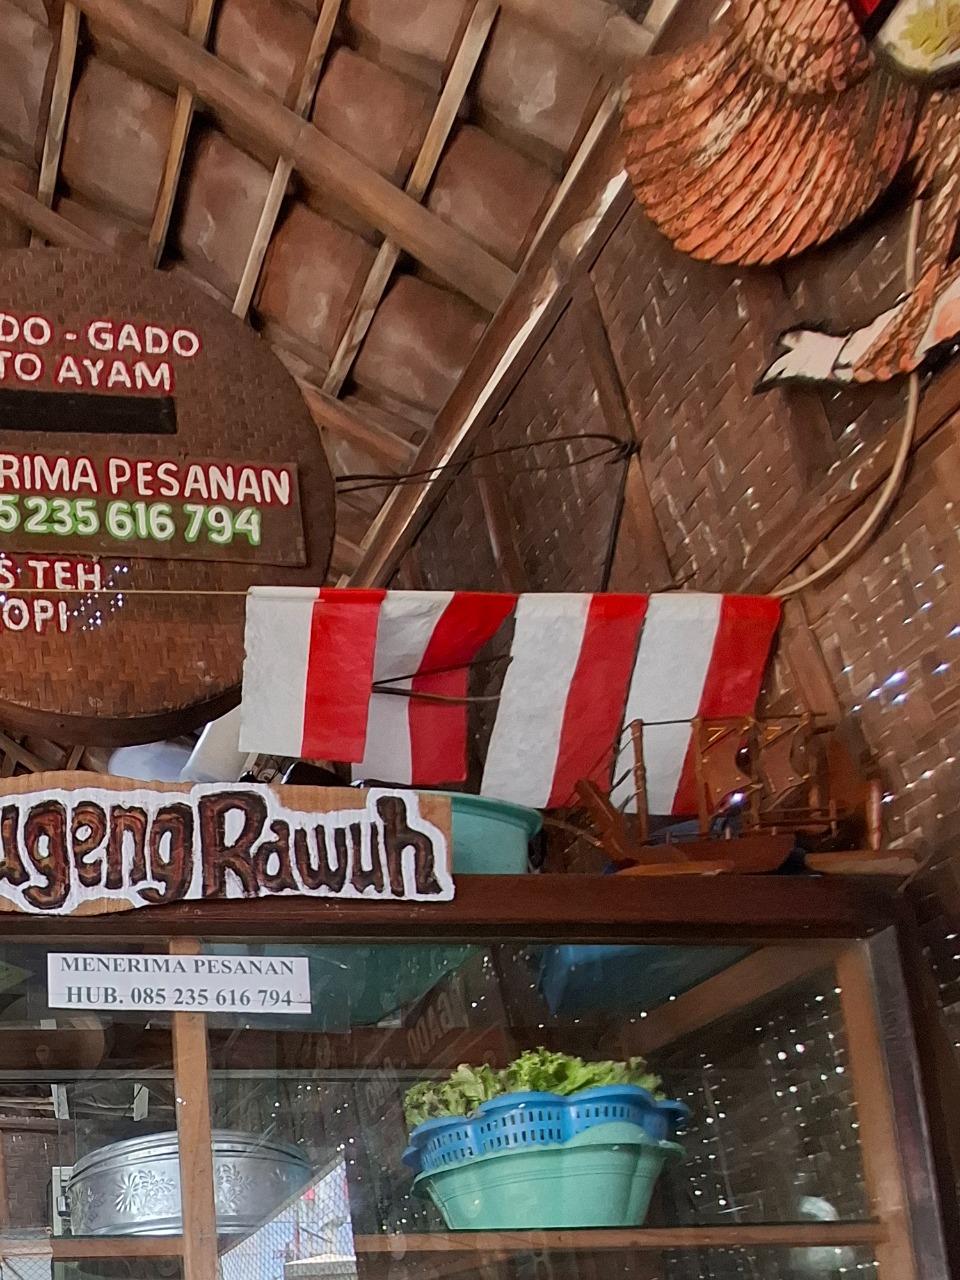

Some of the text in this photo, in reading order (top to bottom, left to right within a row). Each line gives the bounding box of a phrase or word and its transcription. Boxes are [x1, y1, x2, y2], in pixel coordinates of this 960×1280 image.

[87, 321, 201, 358] GADO
[57, 357, 171, 391] AYAM
[109, 458, 291, 505] PESANAN
[23, 497, 100, 536] 235
[106, 500, 176, 541] 616
[183, 504, 262, 546] 794
[29, 560, 102, 591] TEH
[200, 789, 444, 898] Rawuh
[60, 956, 295, 976] MENERIMA PESANAN
[66, 985, 292, 1007] HUB. 085 235 616 794
